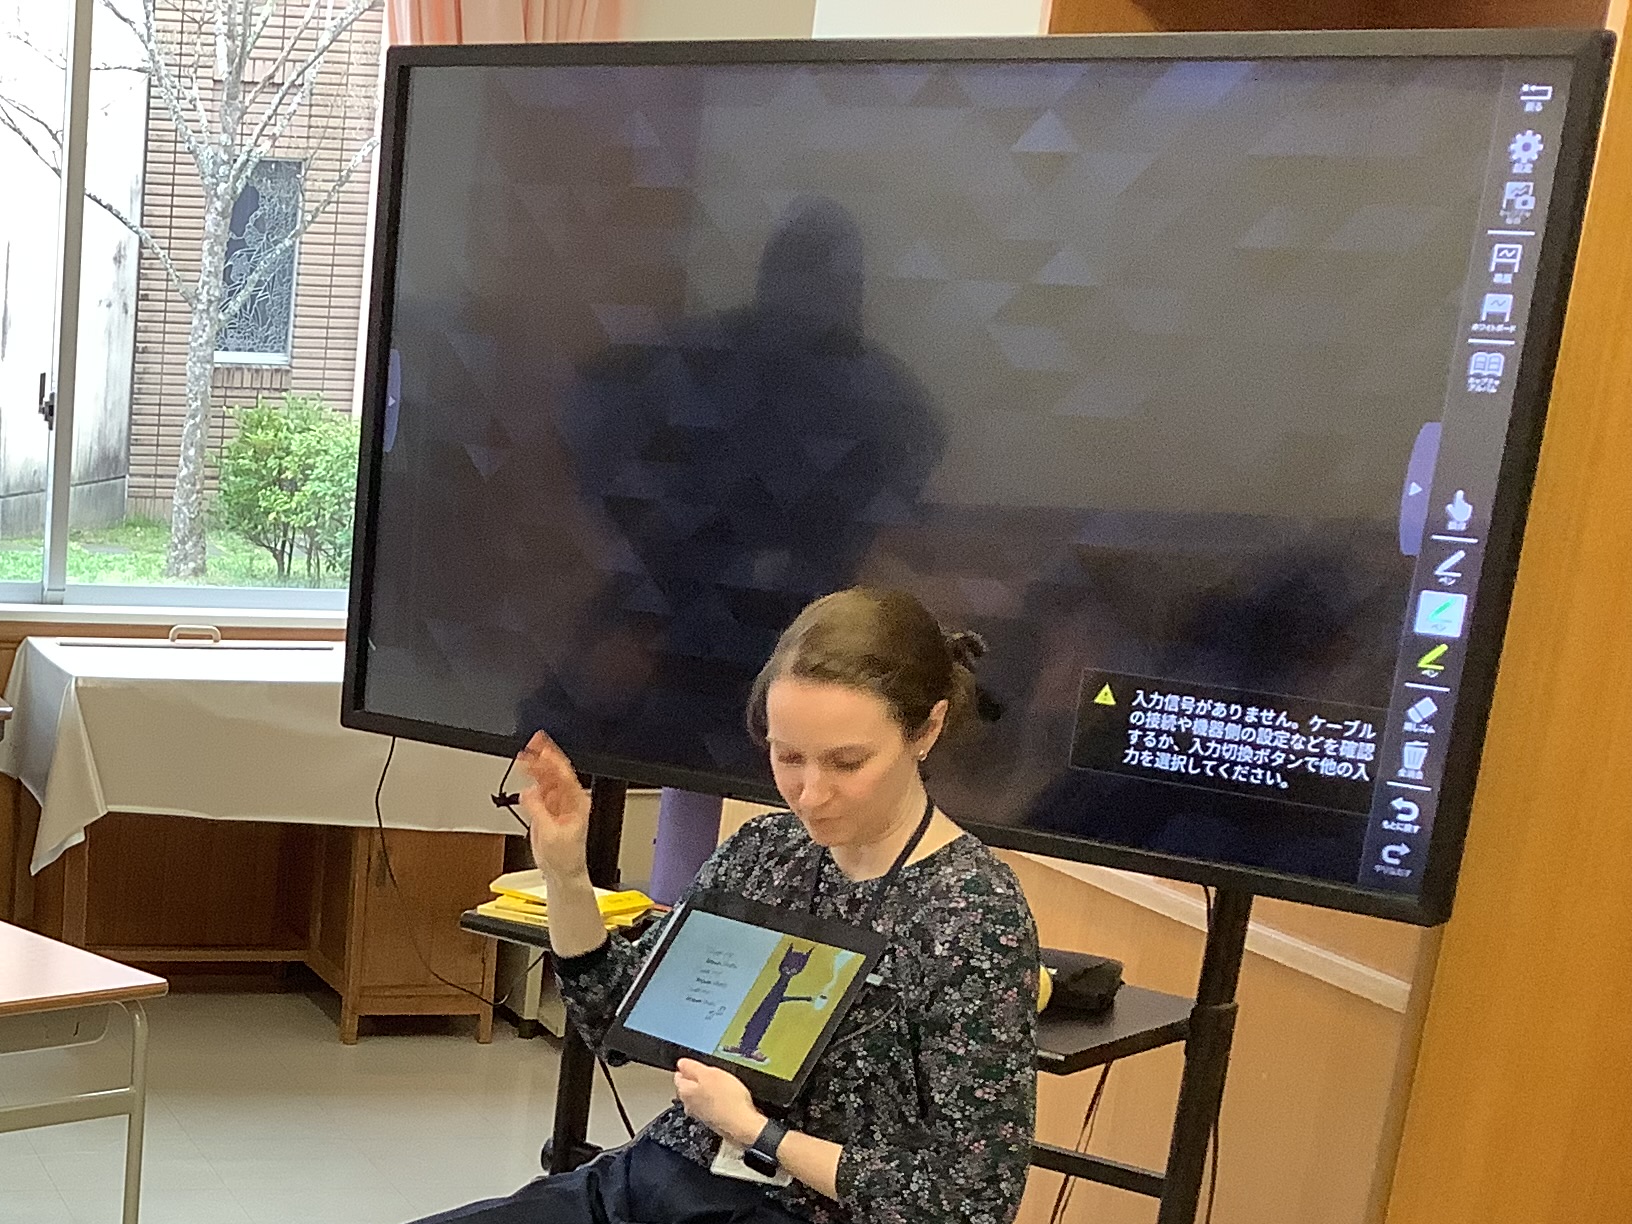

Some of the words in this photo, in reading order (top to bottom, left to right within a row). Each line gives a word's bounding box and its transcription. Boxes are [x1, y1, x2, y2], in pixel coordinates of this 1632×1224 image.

[1127, 729, 1371, 782] するか、入力切換ボタンで他の入
[1129, 711, 1377, 762] の接続や機器側の設定などを確認
[1122, 747, 1291, 790] 力を選択してください。
